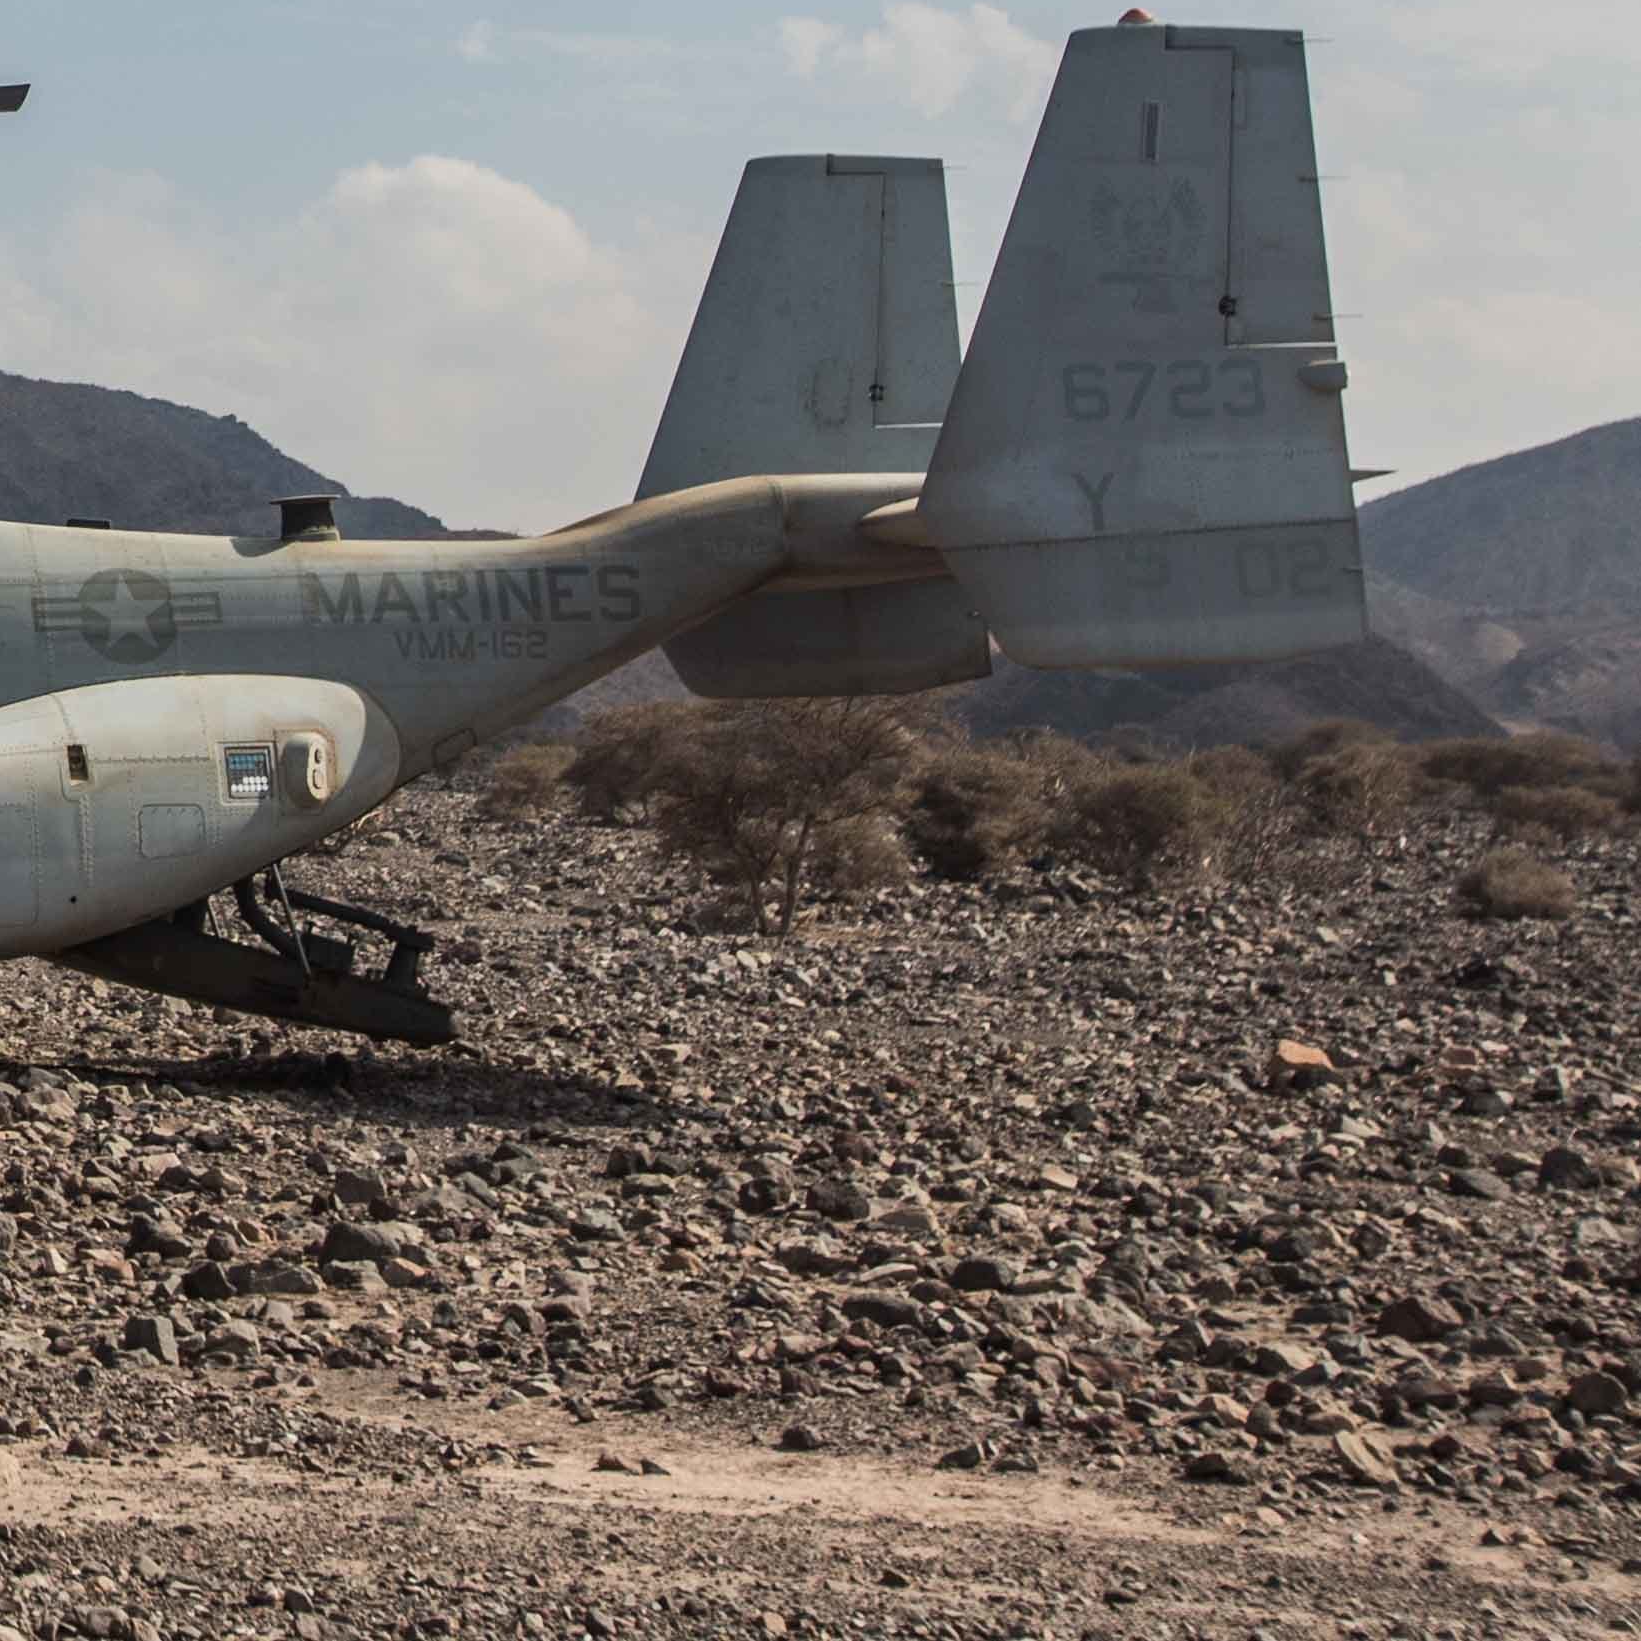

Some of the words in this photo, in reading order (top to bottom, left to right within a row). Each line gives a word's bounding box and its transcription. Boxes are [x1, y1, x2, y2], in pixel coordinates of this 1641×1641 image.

[1062, 358, 1265, 422] 6723
[1071, 471, 1115, 532] Y
[302, 565, 641, 624] MARINES
[1234, 538, 1331, 598] 02
[393, 630, 548, 660] VMM-162
